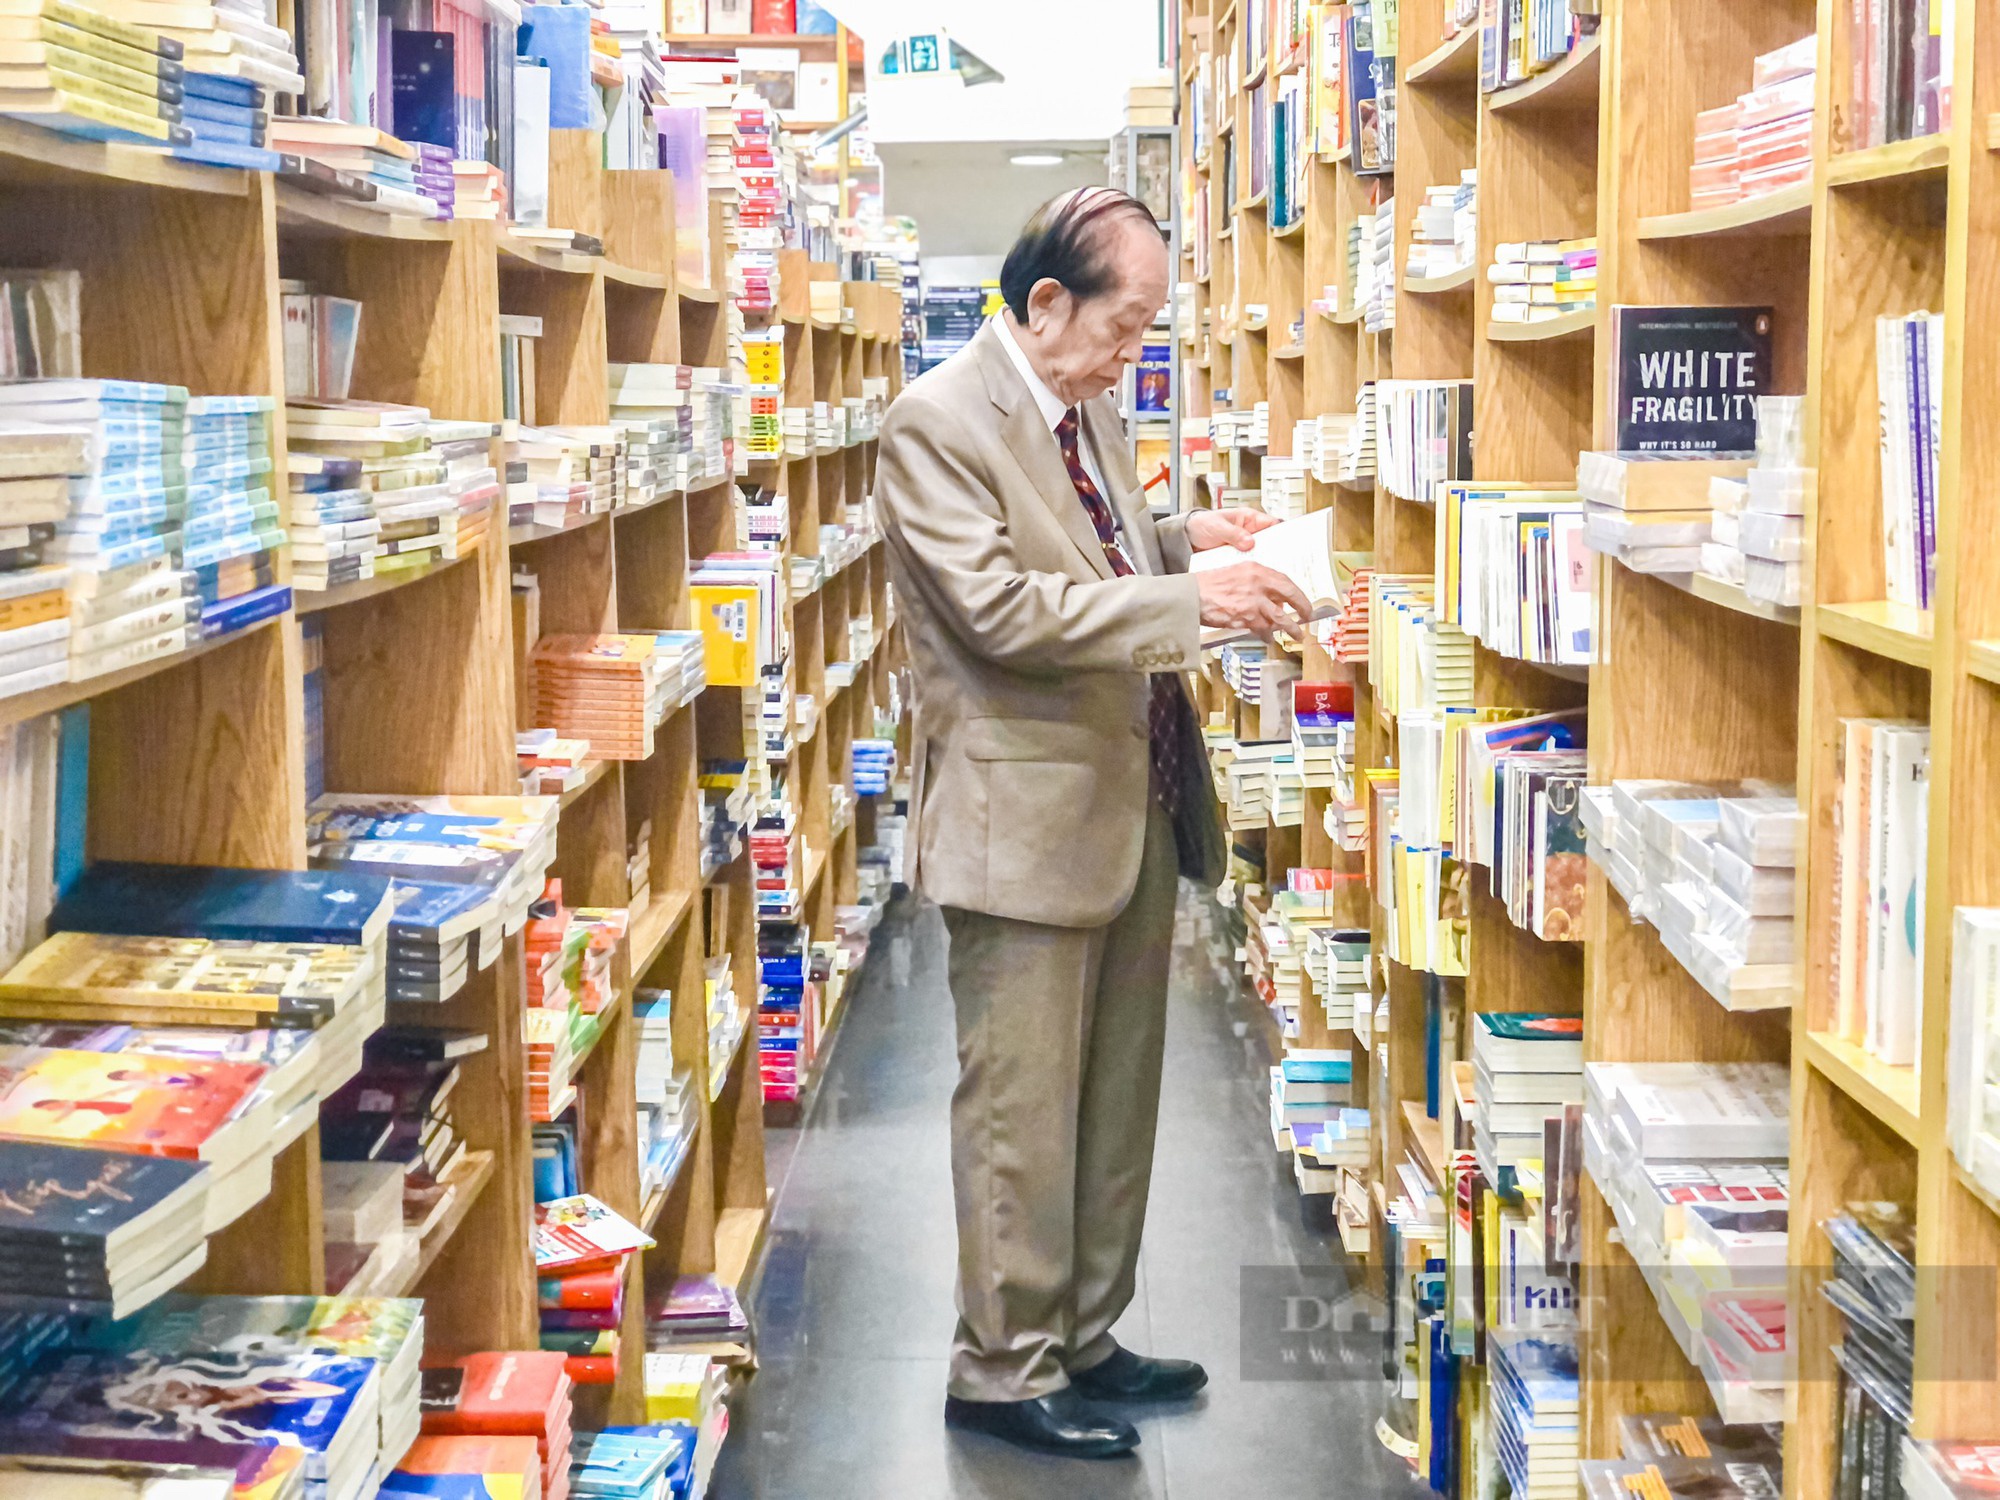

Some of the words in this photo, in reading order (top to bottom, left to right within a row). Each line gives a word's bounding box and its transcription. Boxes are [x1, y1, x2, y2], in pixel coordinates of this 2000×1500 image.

[1639, 349, 1756, 389] WHITE
[1630, 393, 1758, 424] FRAGILITY
[1639, 441, 1658, 450] WHY
[1661, 441, 1678, 450] IT'S
[1680, 440, 1692, 450] SO
[1694, 440, 1717, 449] HARD
